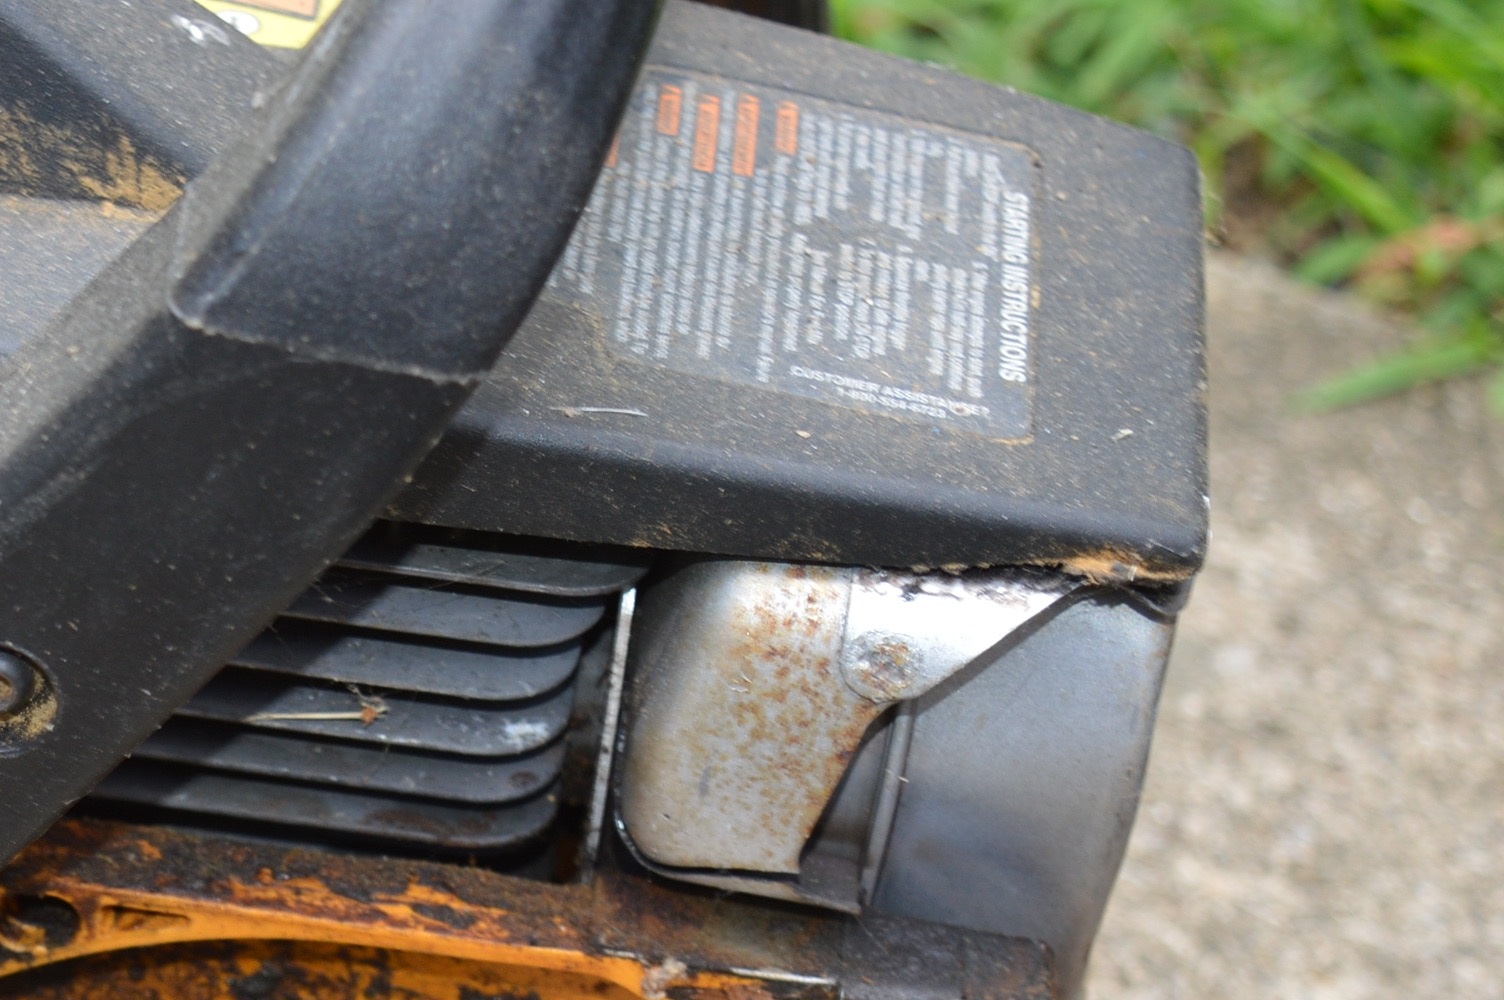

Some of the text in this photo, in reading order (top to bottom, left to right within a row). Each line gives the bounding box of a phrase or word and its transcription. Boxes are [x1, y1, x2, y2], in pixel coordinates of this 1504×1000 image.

[999, 191, 1030, 383] STARTING INSTRUCTIONS
[789, 365, 879, 394] CUSTOMER
